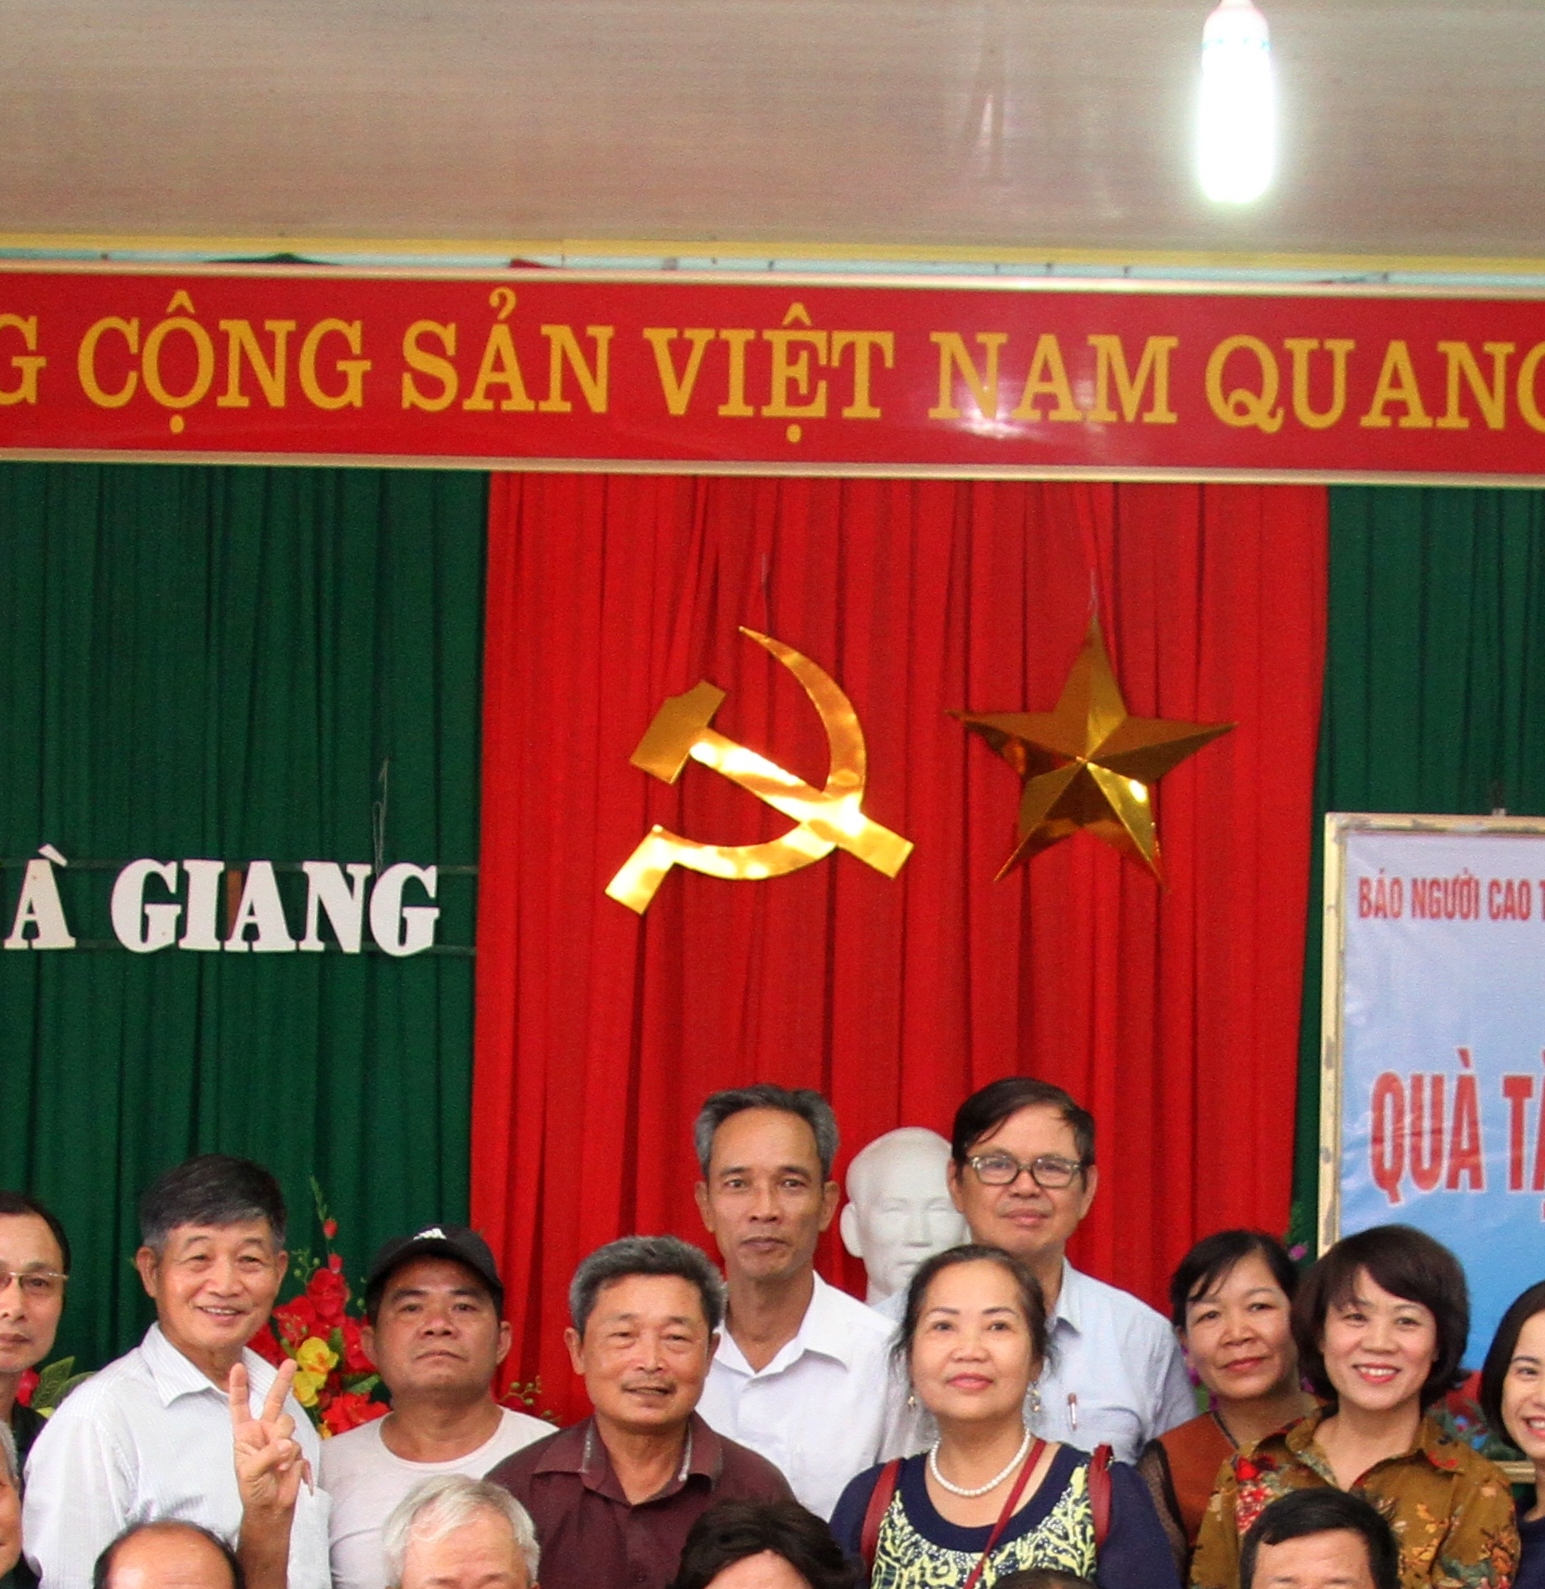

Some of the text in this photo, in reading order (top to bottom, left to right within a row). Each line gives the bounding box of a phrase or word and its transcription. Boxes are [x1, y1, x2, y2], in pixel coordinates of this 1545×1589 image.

[79, 291, 371, 432] CỘNG
[403, 281, 623, 412] SẢN
[643, 303, 894, 442] VIỆT
[928, 332, 1179, 430] NAM
[111, 859, 439, 956] GIANG
[1358, 868, 1404, 919] BÁO
[1410, 868, 1482, 920] NGƯỜI
[1487, 878, 1533, 921] CAO
[1372, 1050, 1483, 1203] QUÀ
